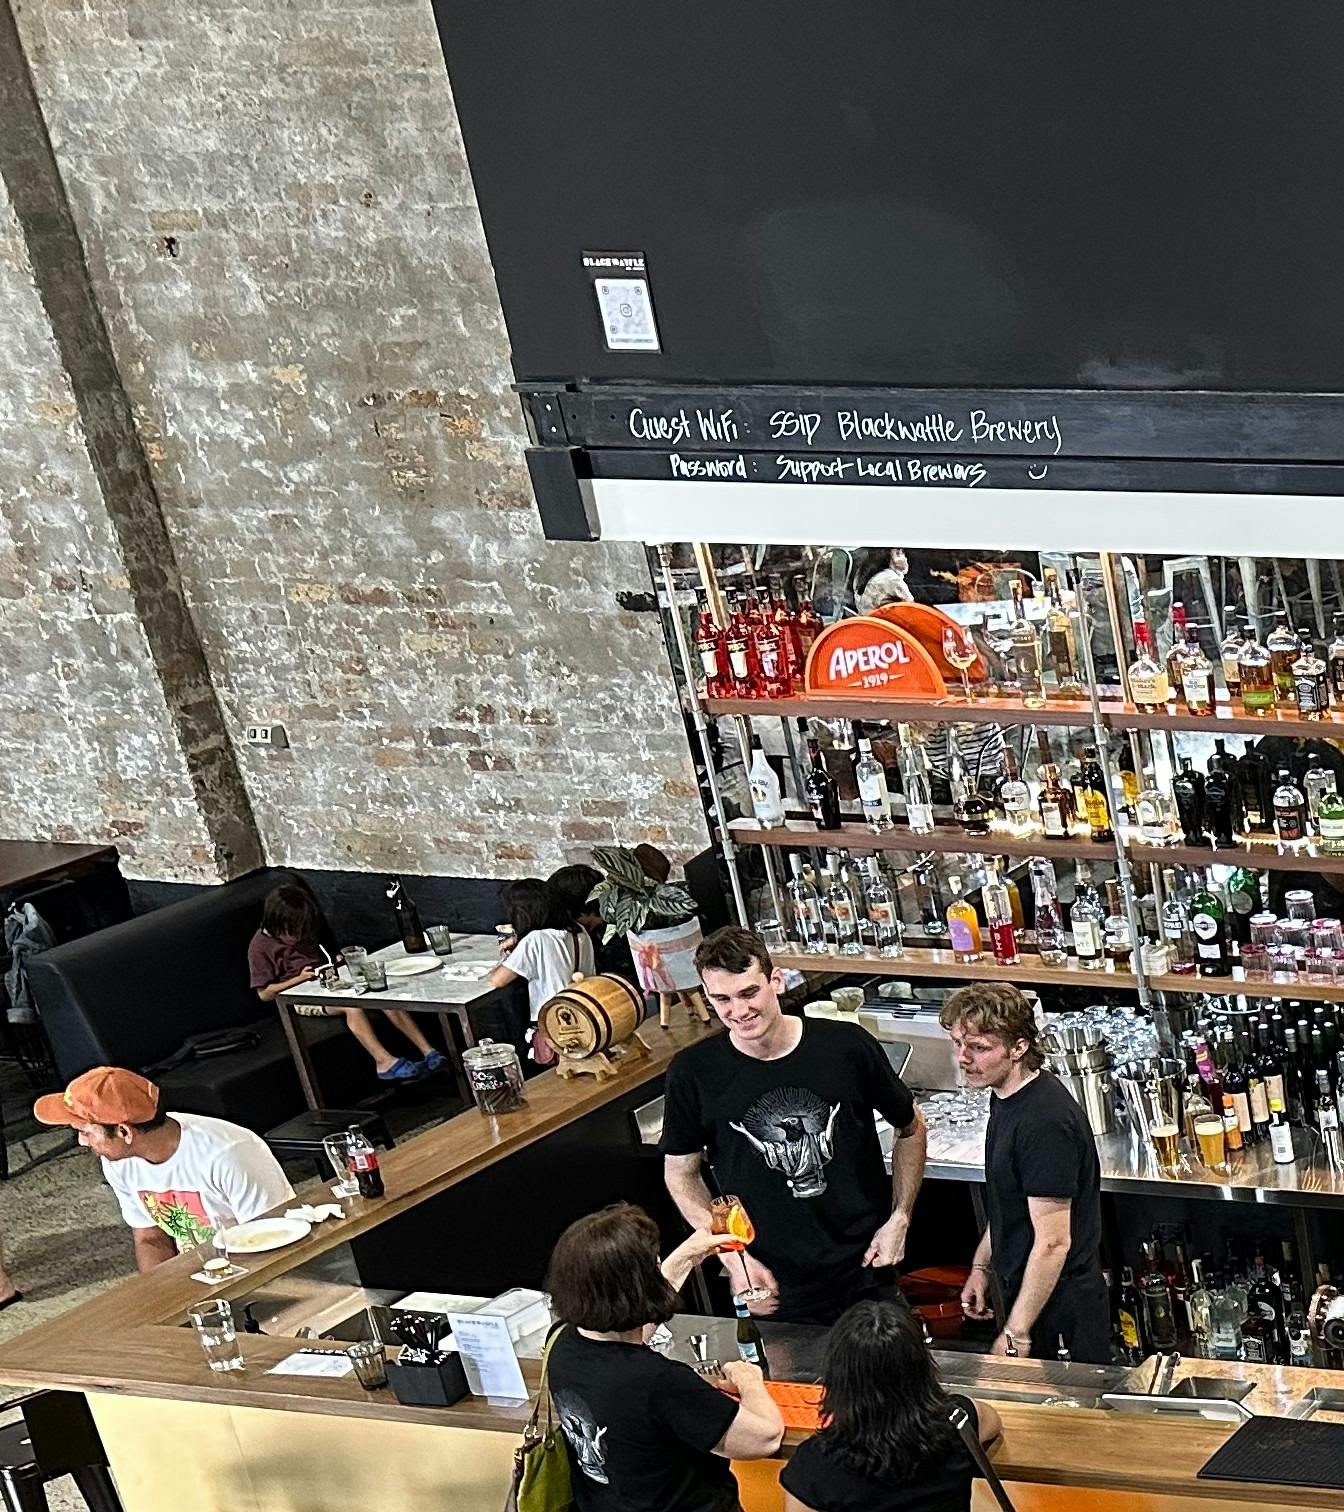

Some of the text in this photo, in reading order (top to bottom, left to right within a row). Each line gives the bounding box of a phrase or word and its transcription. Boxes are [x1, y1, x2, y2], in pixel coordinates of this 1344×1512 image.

[629, 408, 691, 445] Guest
[769, 410, 822, 446] SSID
[837, 410, 964, 442] Blackwattle
[970, 409, 1062, 456] Brewery
[776, 454, 854, 483] Support
[856, 457, 903, 482] Local
[829, 640, 911, 682] APEROL
[861, 673, 889, 689] 1919
